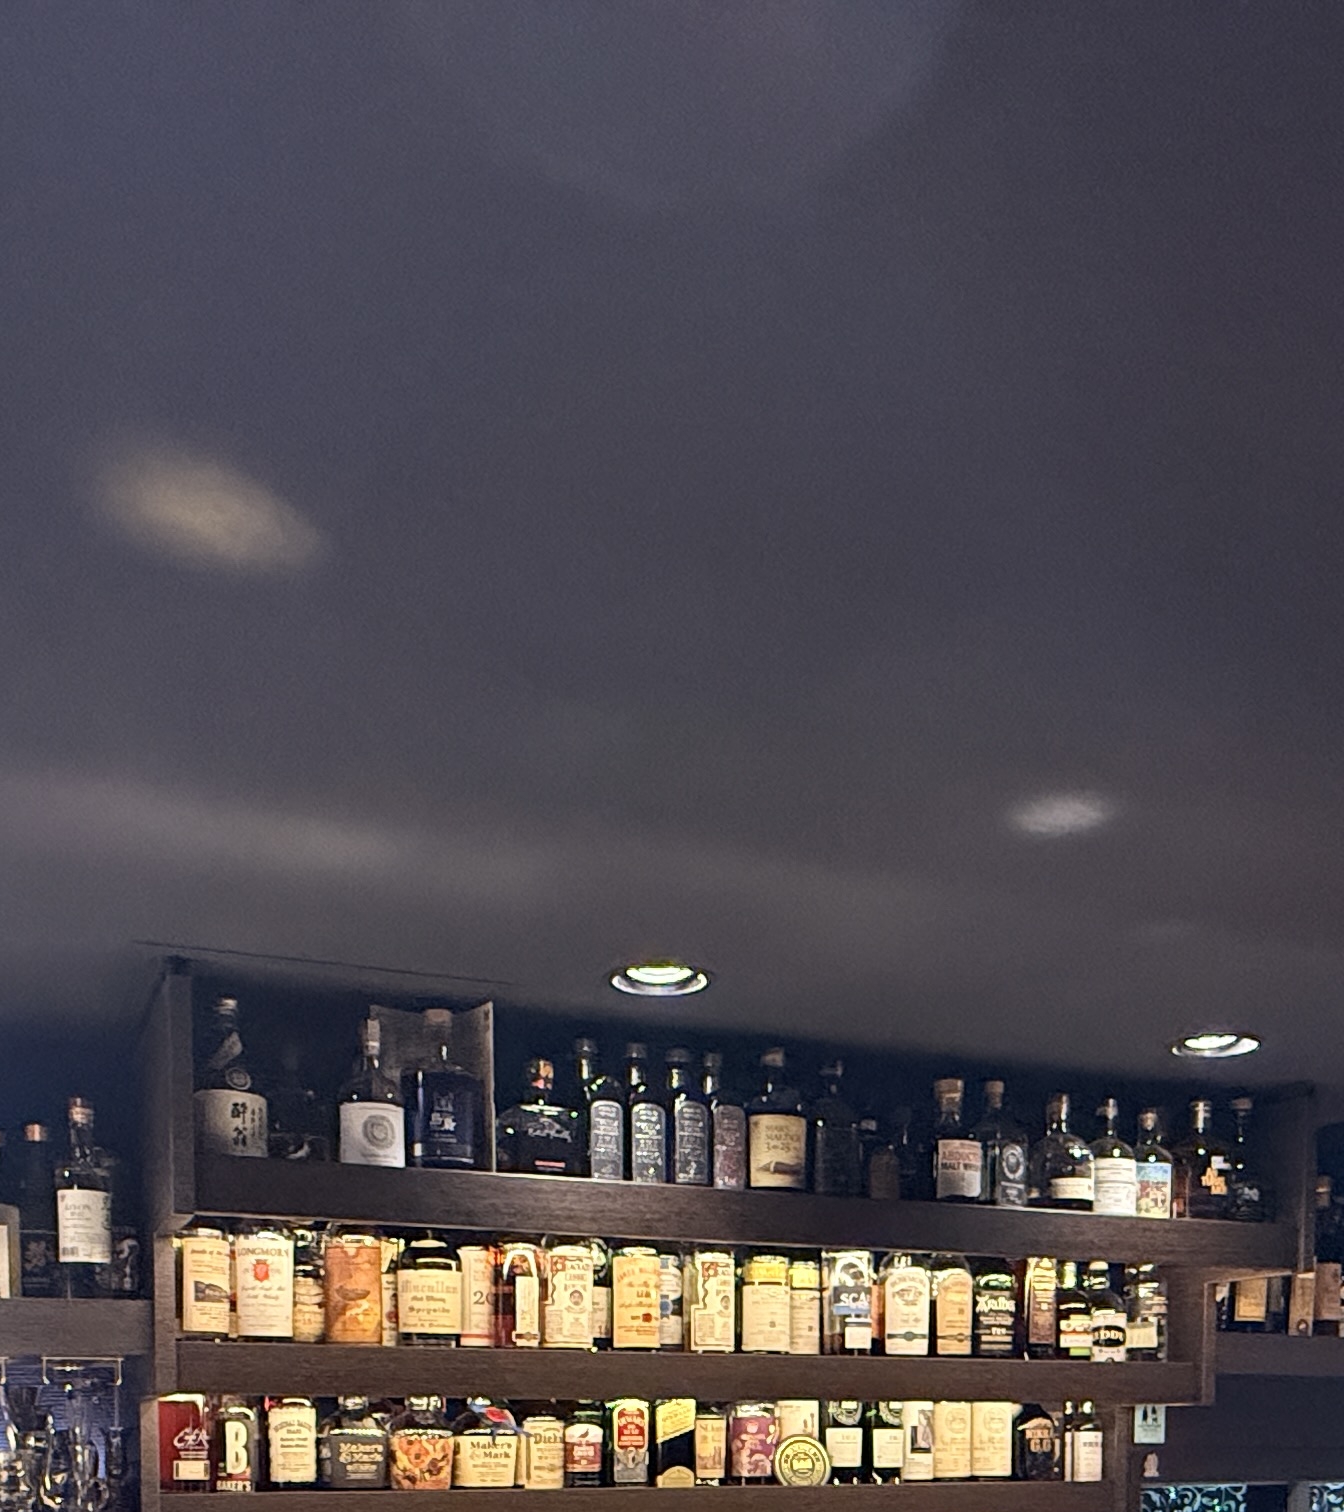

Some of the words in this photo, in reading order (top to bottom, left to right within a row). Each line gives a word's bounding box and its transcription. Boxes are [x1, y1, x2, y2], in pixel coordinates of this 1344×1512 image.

[224, 1420, 249, 1475] B
[338, 1442, 384, 1453] Maker's
[470, 1440, 513, 1450] Maker's
[350, 1452, 384, 1462] Mark
[483, 1450, 511, 1460] Mark
[216, 1480, 252, 1492] BAKER'S
